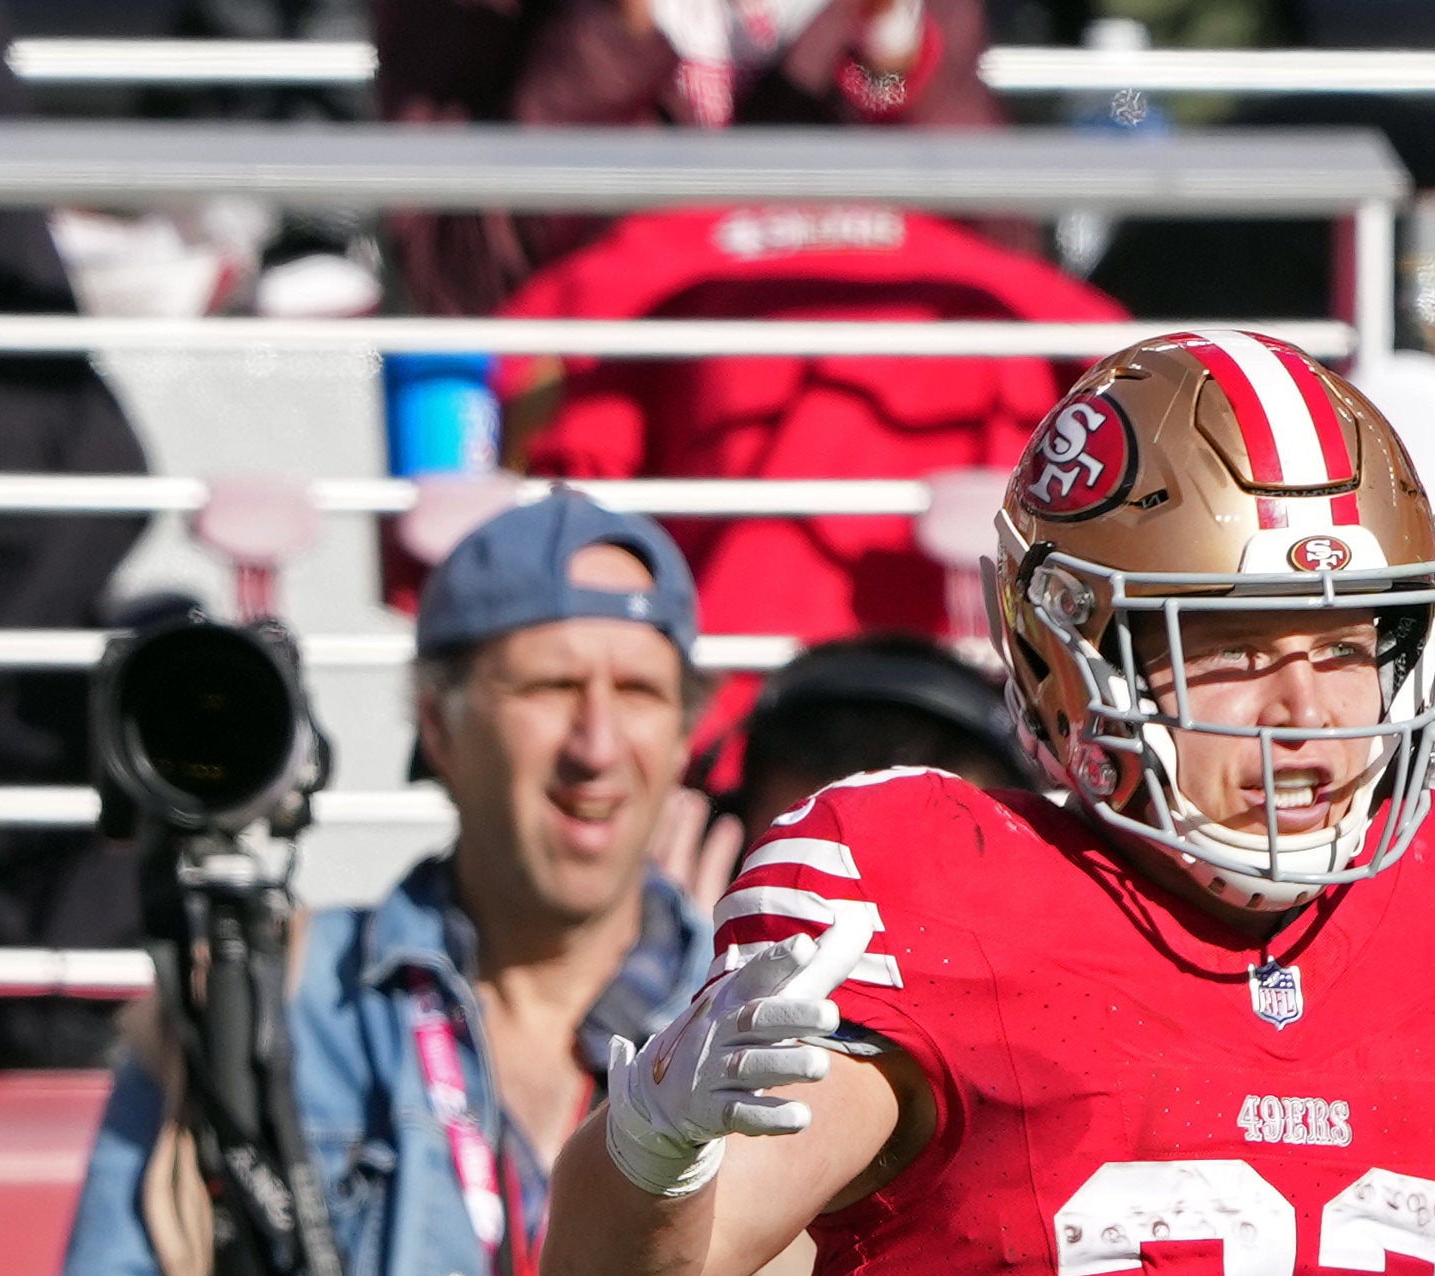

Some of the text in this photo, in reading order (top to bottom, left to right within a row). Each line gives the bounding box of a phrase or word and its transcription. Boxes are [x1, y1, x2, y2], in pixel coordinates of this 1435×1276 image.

[1027, 402, 1107, 504] SF
[1305, 539, 1344, 571] SF
[1259, 987, 1296, 1017] NFL
[1237, 1094, 1353, 1148] 49ERS
